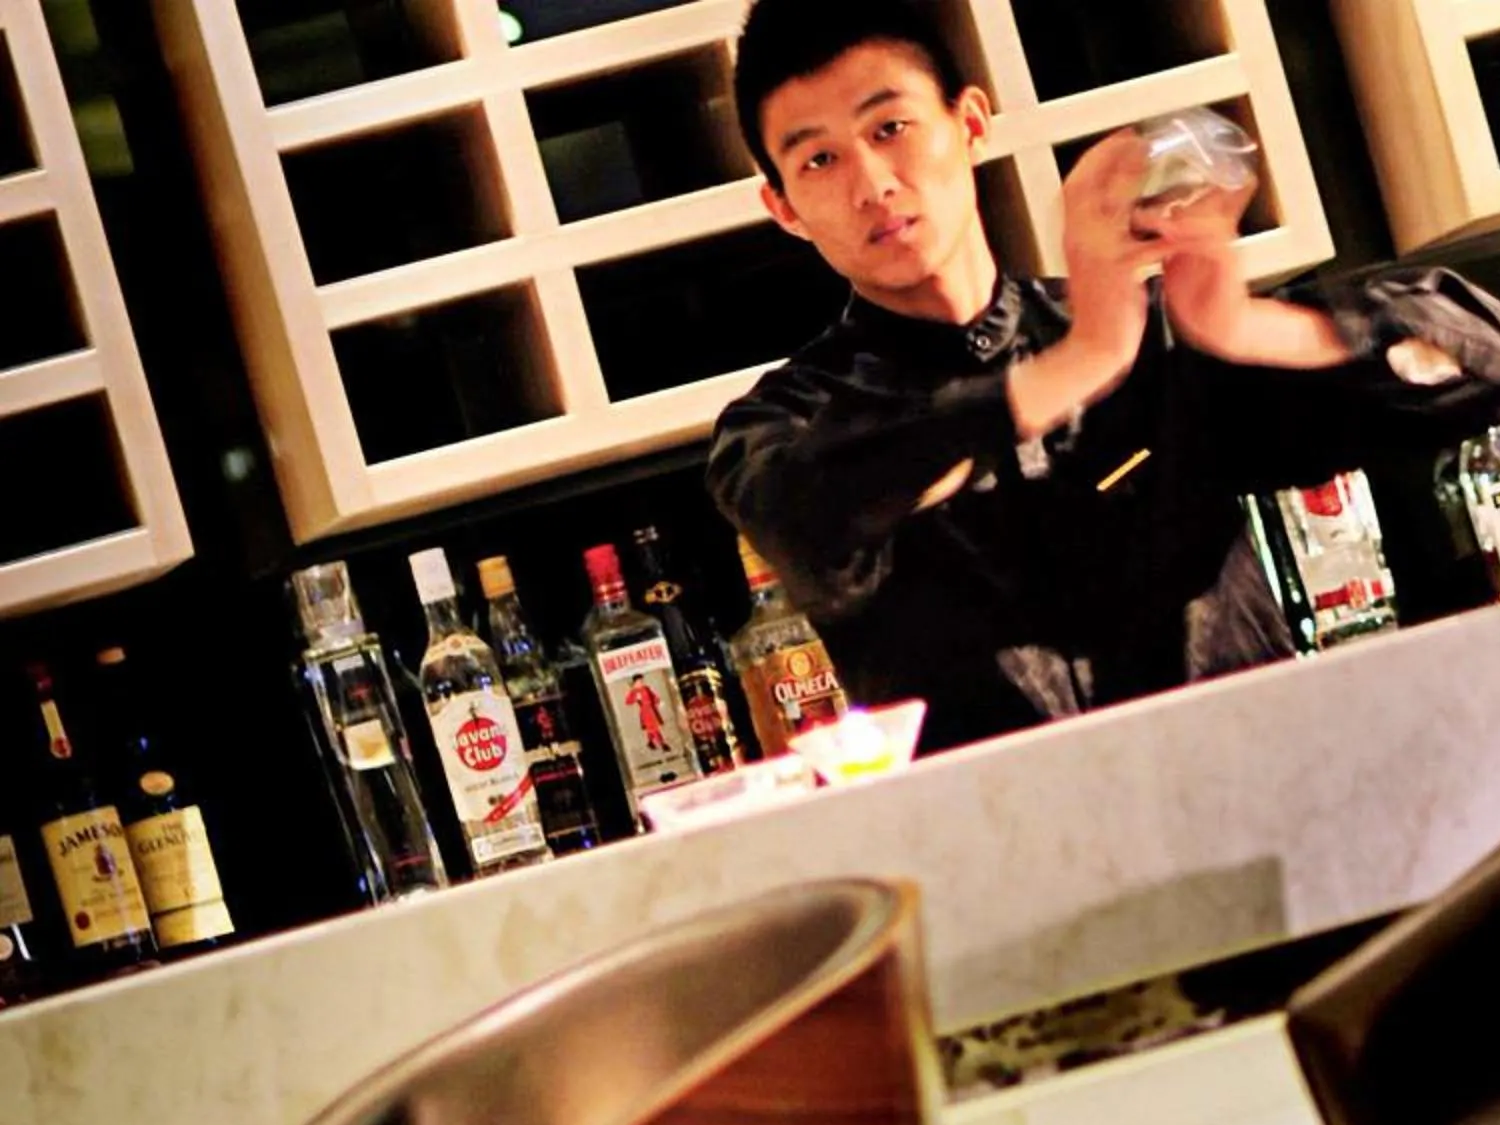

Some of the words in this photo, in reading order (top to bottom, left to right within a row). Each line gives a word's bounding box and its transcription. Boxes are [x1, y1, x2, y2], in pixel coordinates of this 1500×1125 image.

[775, 671, 839, 703] OLMECA
[464, 742, 503, 767] Club
[59, 822, 124, 858] JAMESO
